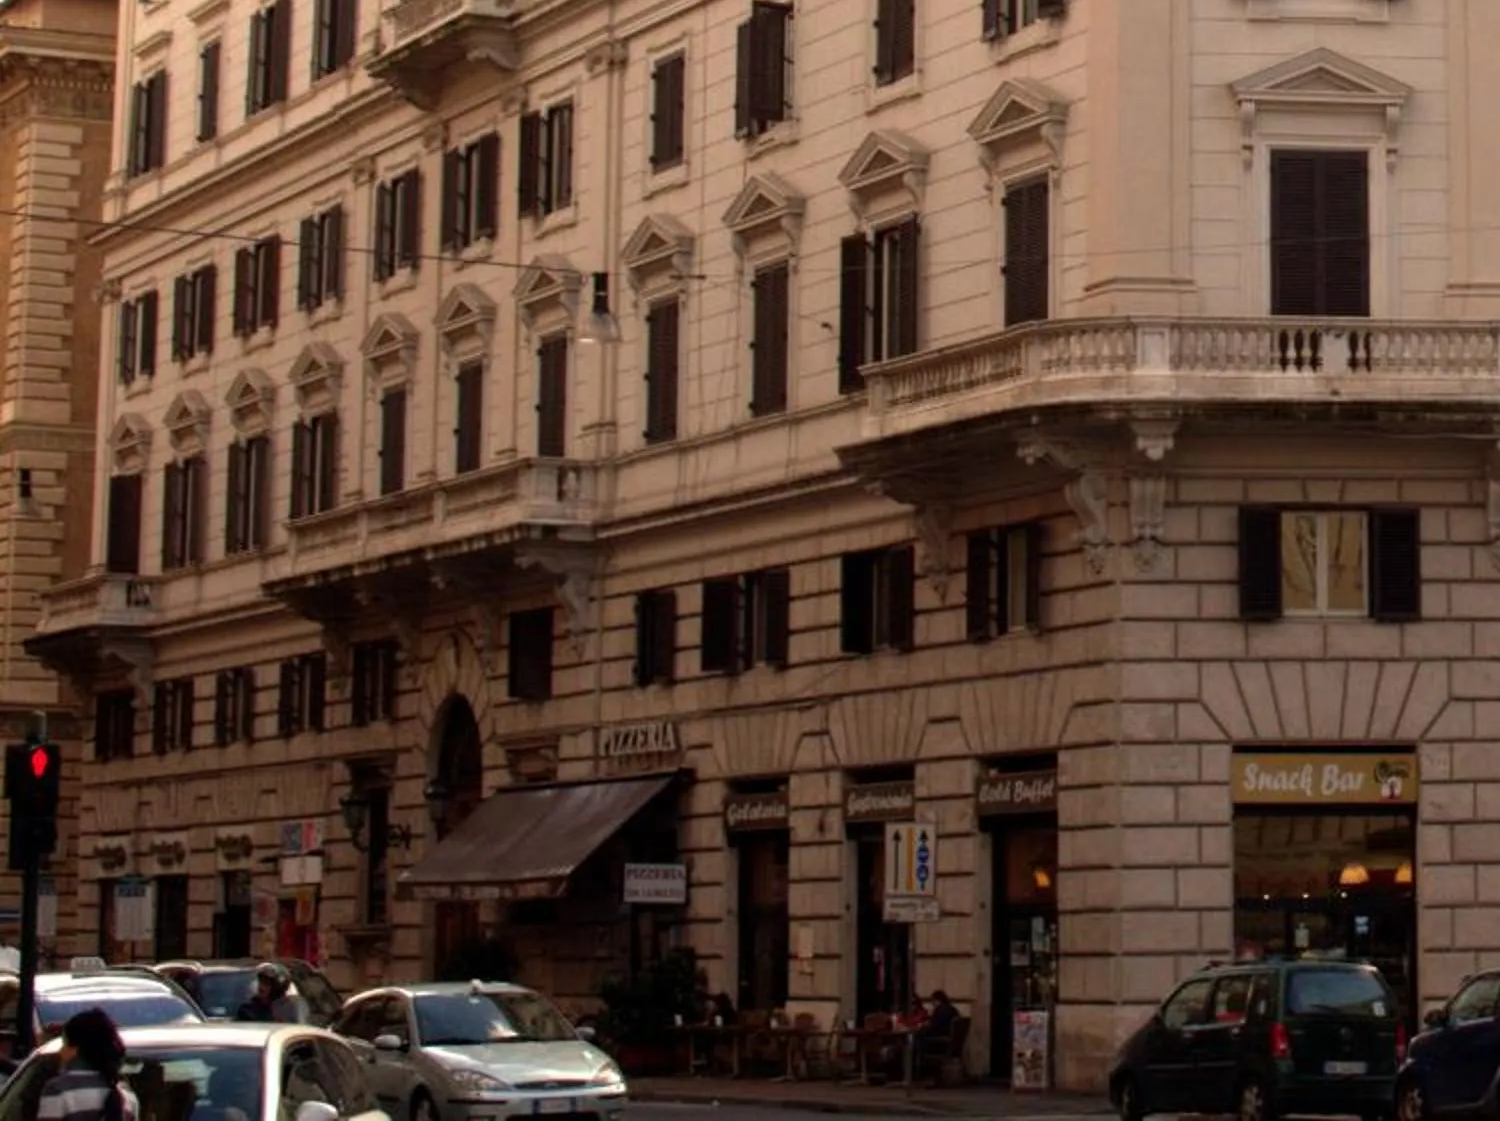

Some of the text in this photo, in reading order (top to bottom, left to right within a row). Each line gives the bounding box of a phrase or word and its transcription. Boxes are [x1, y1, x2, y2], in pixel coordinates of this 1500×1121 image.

[599, 722, 676, 757] PIZZERIA
[1244, 762, 1313, 797] Snack
[1320, 763, 1365, 796] Bar
